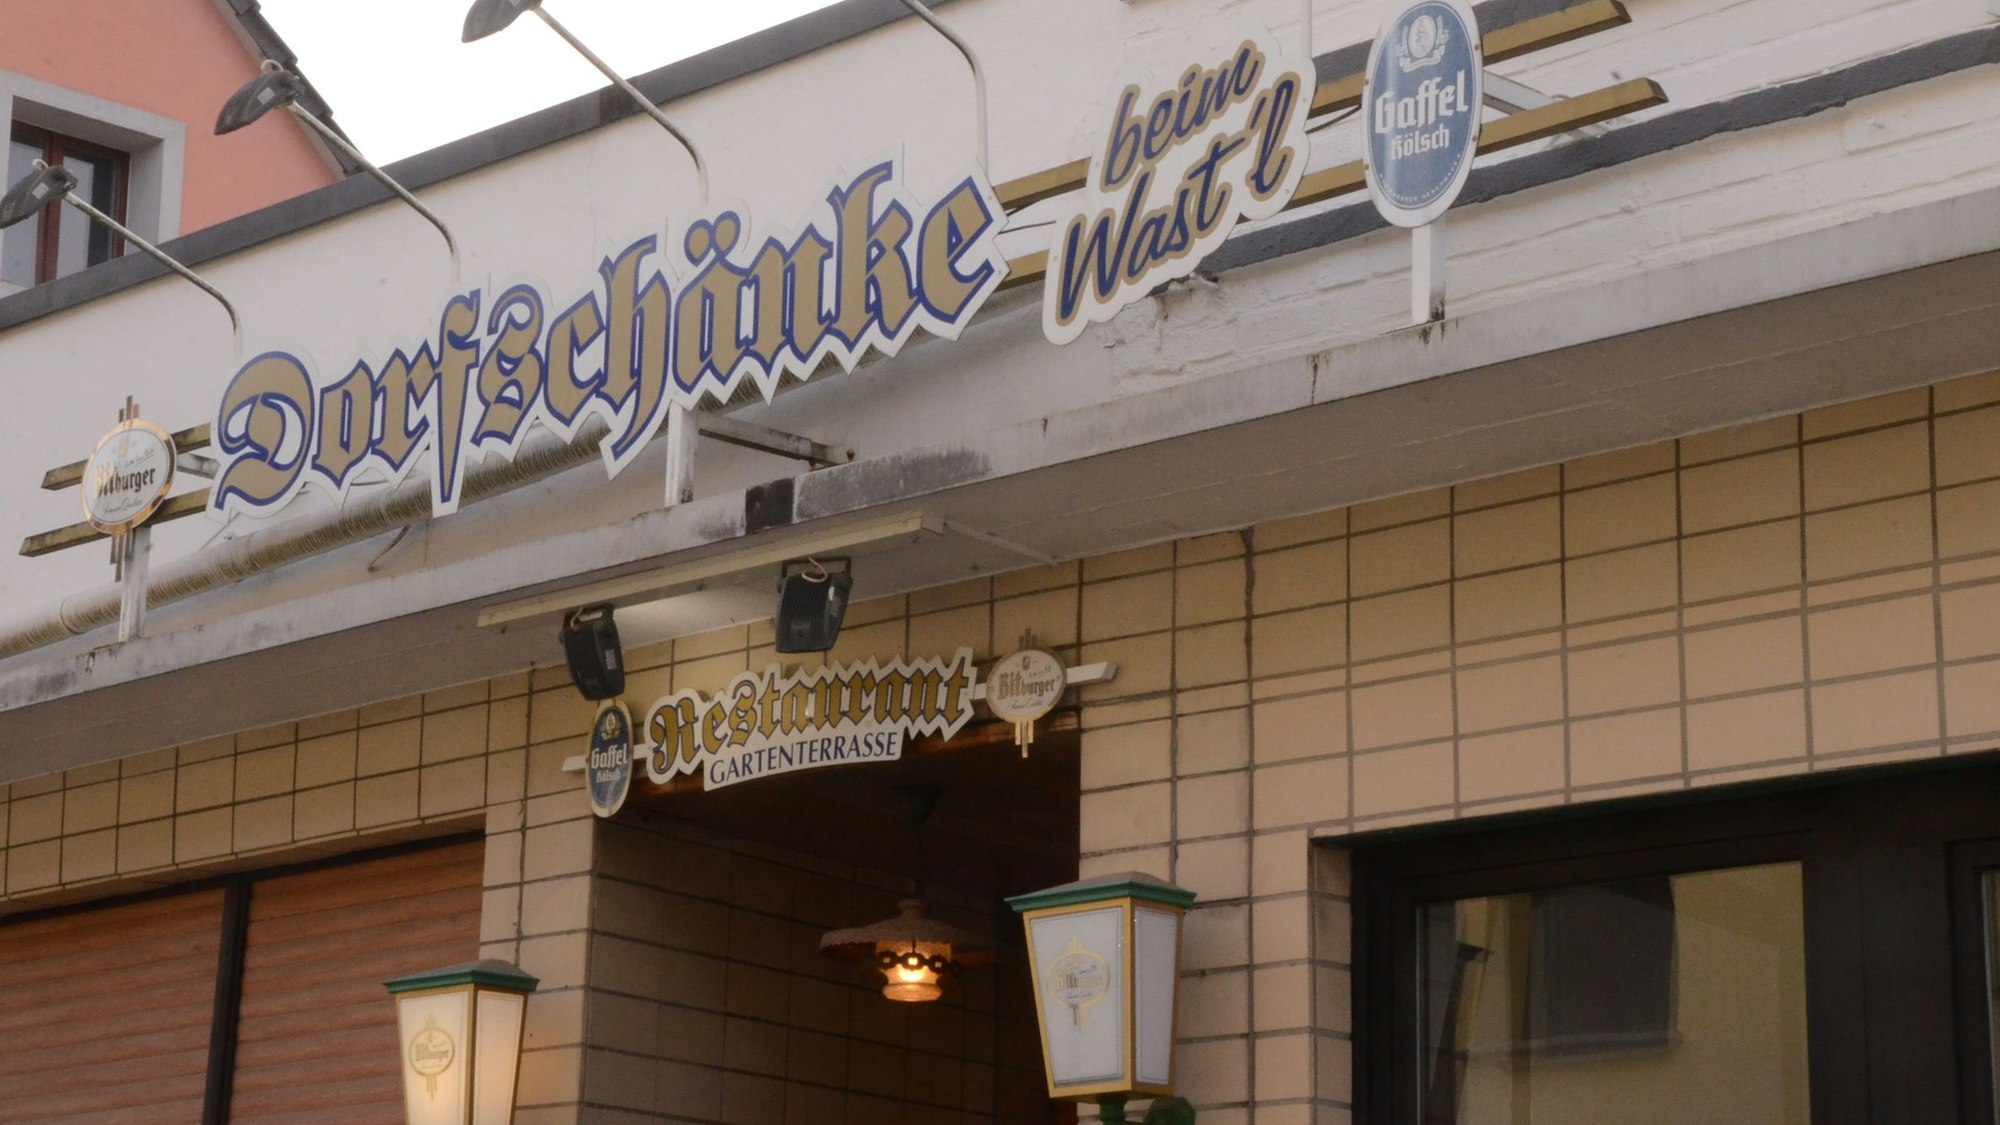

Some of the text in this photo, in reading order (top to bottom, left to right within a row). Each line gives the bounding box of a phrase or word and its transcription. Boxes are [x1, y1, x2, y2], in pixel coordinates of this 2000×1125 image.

[1100, 39, 1266, 194] beim
[1375, 69, 1469, 134] Gaffel
[1390, 123, 1450, 160] Kölsch
[214, 160, 994, 512] Dorfschänke
[997, 671, 1055, 700] Bitburger
[649, 656, 970, 776] Restaurant
[591, 743, 628, 769] Gaffel
[709, 731, 898, 784] GARTENTERRASSE
